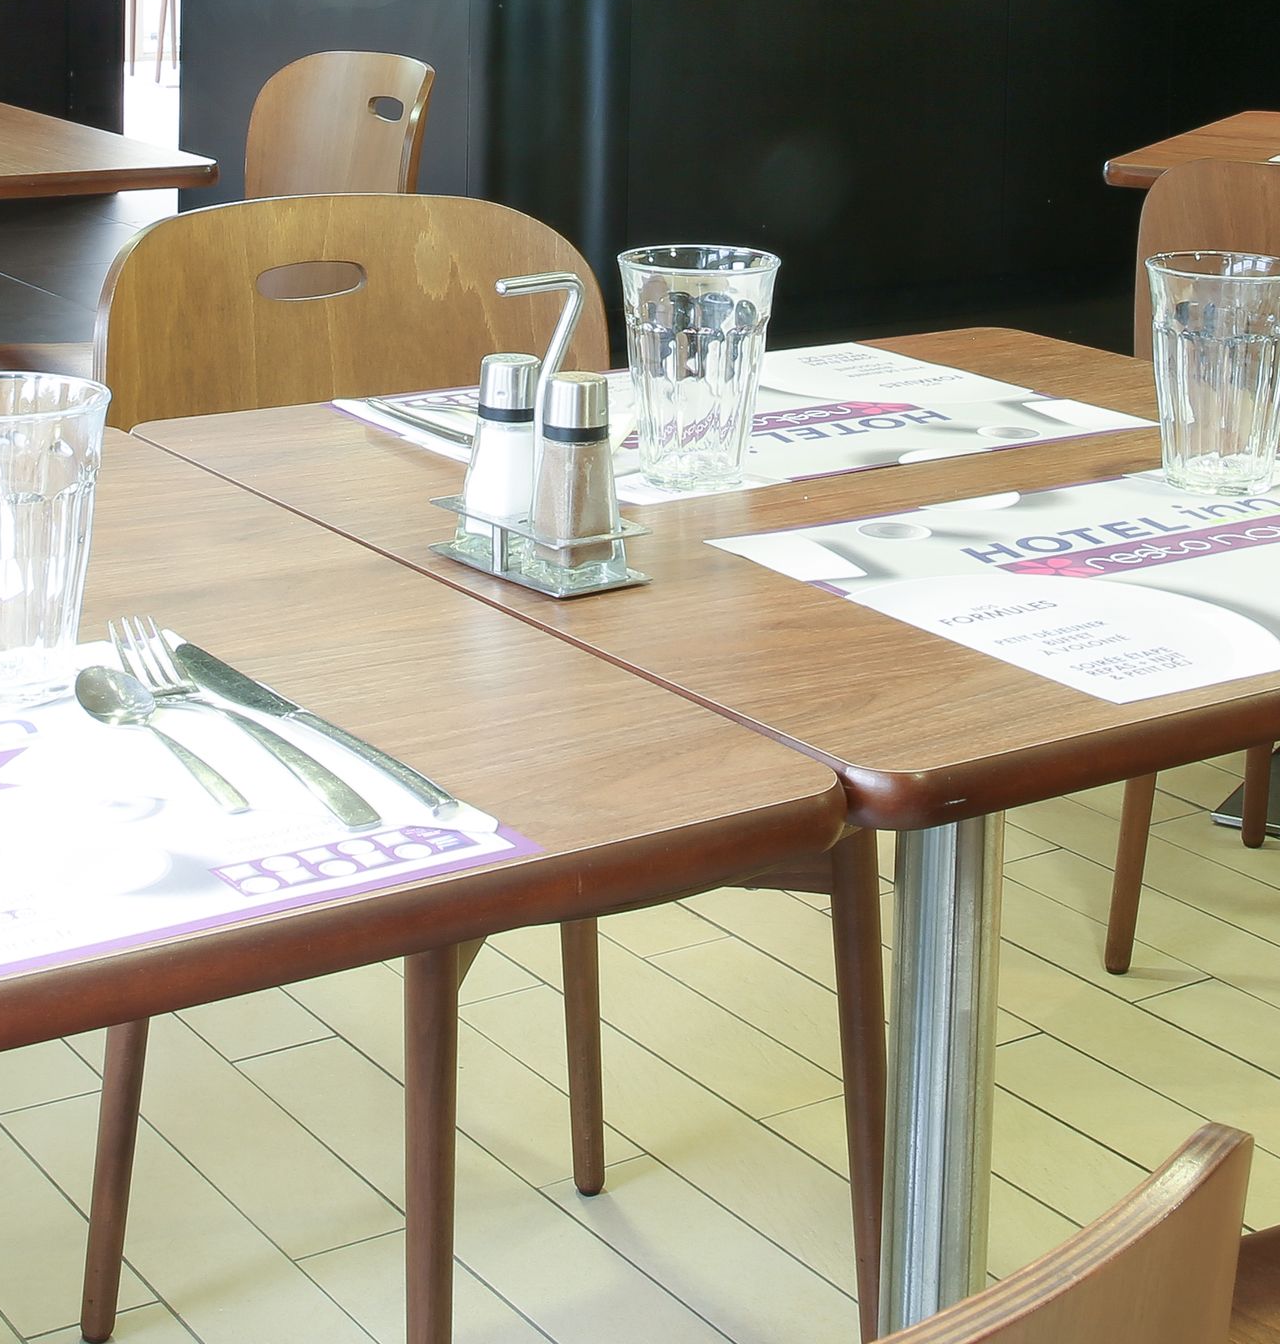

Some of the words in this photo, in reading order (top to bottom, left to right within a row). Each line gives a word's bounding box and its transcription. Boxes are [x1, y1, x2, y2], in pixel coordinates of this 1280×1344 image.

[751, 409, 952, 444] HOTEL
[961, 517, 1187, 564] HOTEL
[1085, 536, 1211, 570] resto
[939, 600, 1058, 627] FORMULES
